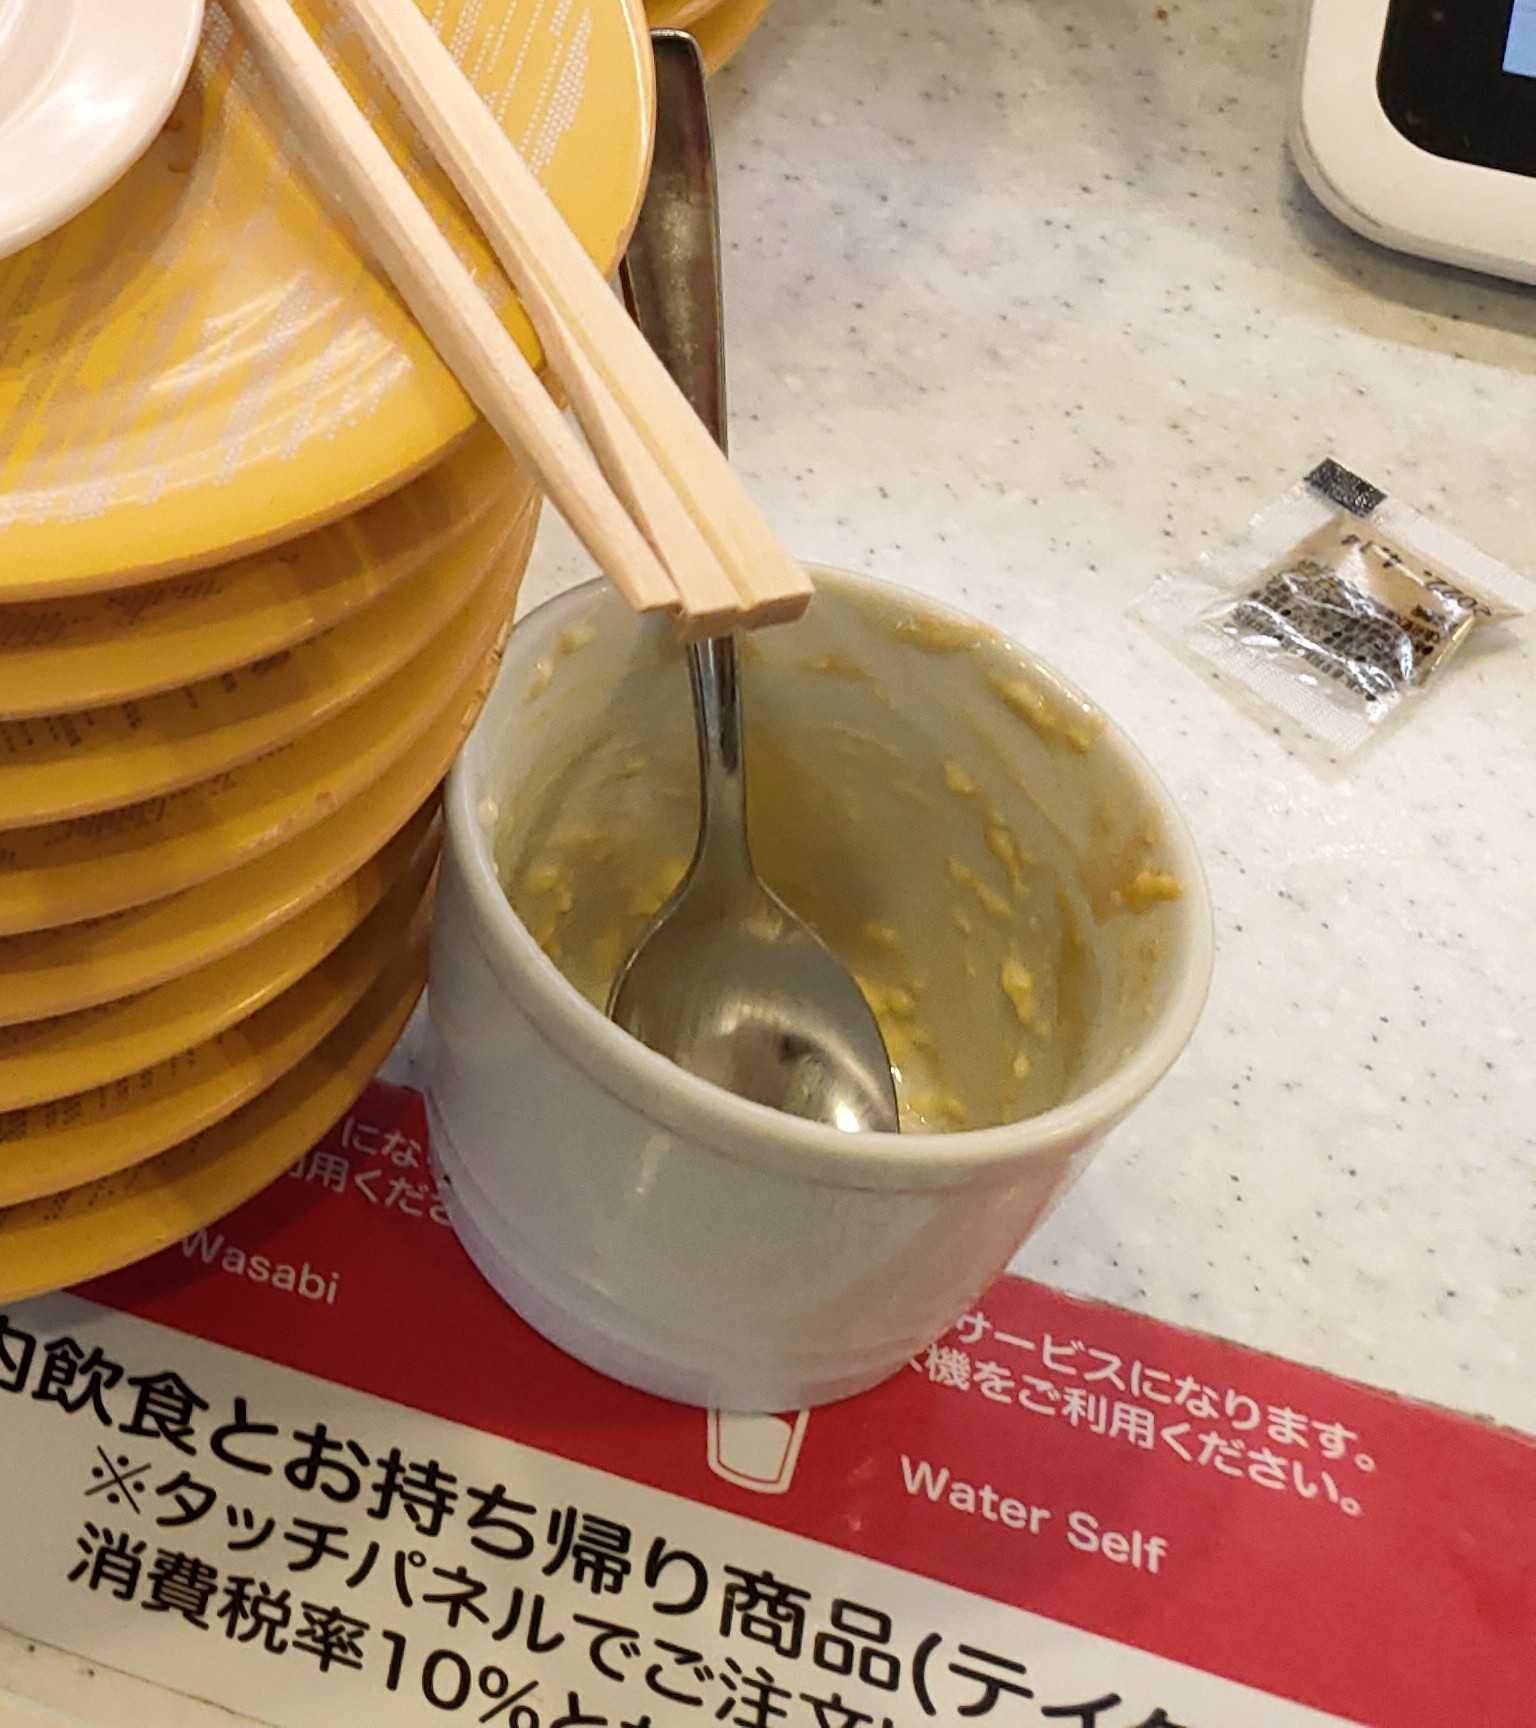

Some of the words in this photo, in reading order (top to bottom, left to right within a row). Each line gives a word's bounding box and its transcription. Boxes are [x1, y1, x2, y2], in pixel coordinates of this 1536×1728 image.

[341, 1117, 430, 1169] にな
[181, 1229, 340, 1304] Wasabi
[909, 1343, 1362, 1518] 機をご利用ください。
[899, 1454, 1051, 1537] Water
[1067, 1510, 1168, 1574] Self
